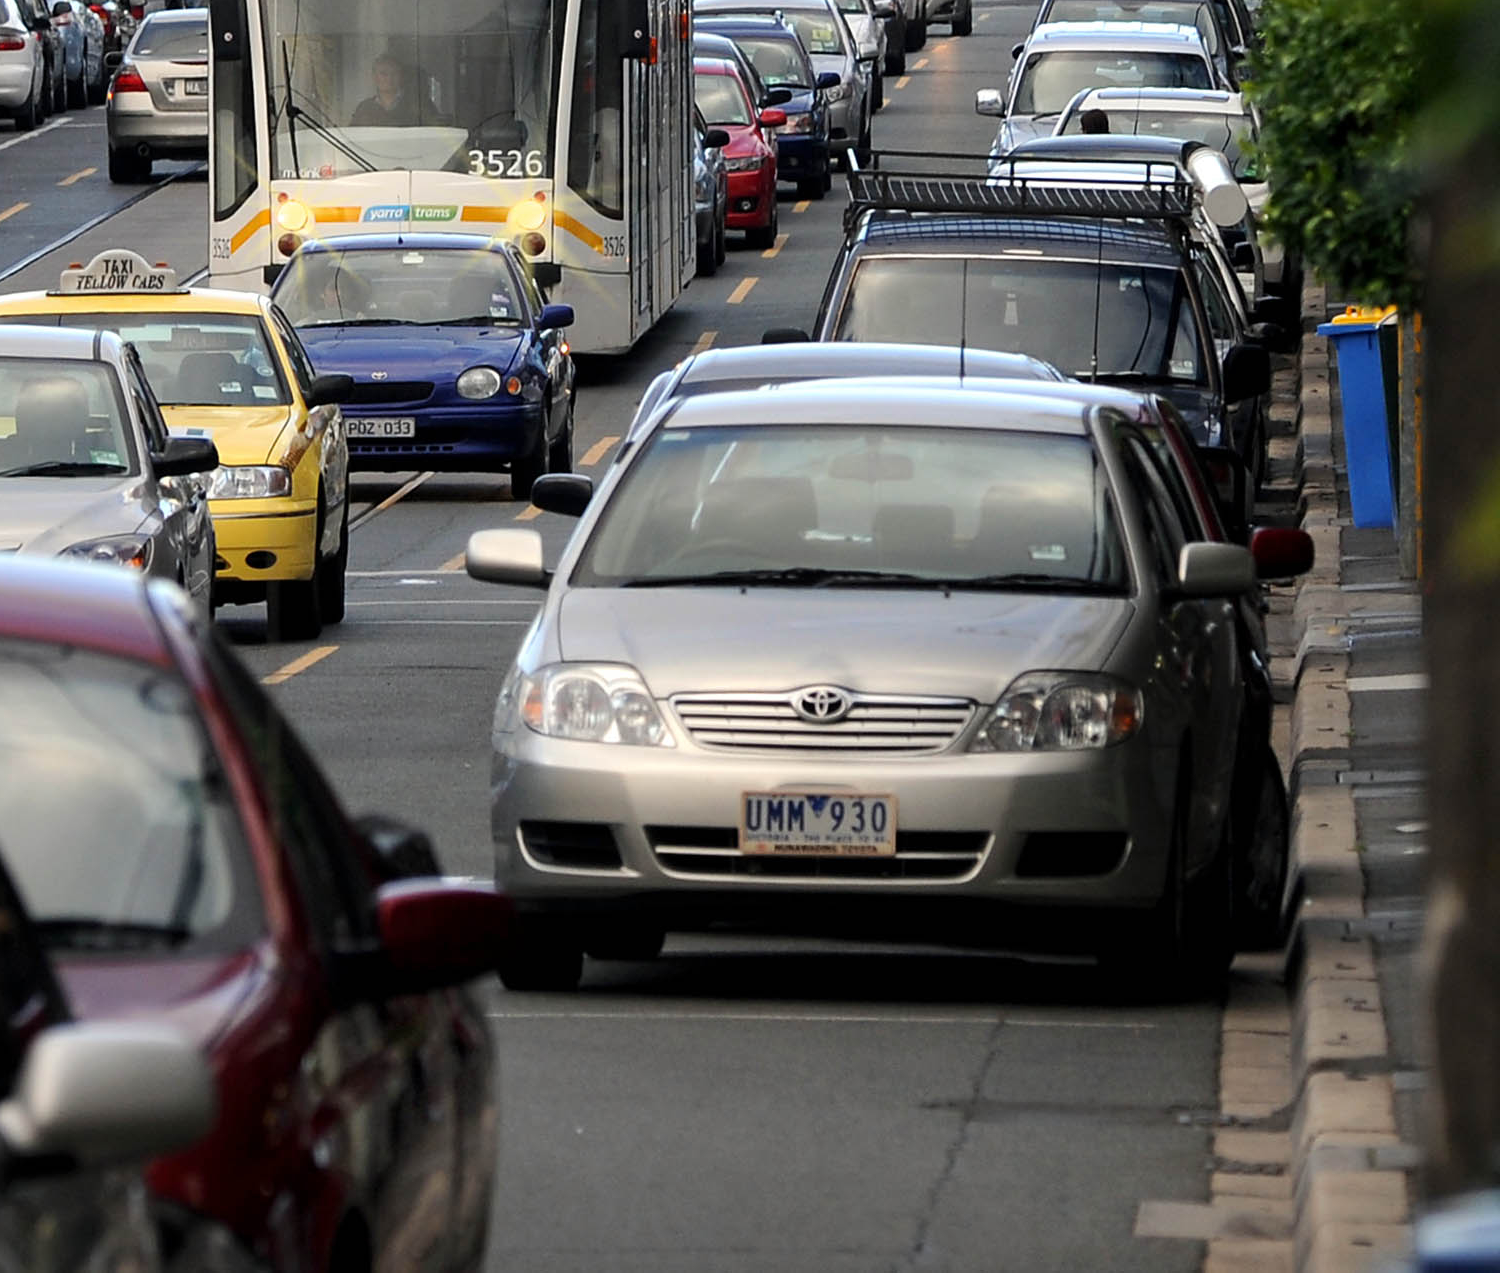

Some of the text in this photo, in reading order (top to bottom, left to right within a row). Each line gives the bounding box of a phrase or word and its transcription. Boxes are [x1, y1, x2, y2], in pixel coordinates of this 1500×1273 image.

[468, 149, 543, 177] 3526
[368, 206, 451, 222] yarra trams
[603, 236, 626, 257] 3526
[103, 259, 134, 275] TAXI
[76, 275, 165, 290] YELLOW CABS
[746, 799, 887, 833] UMM 930
